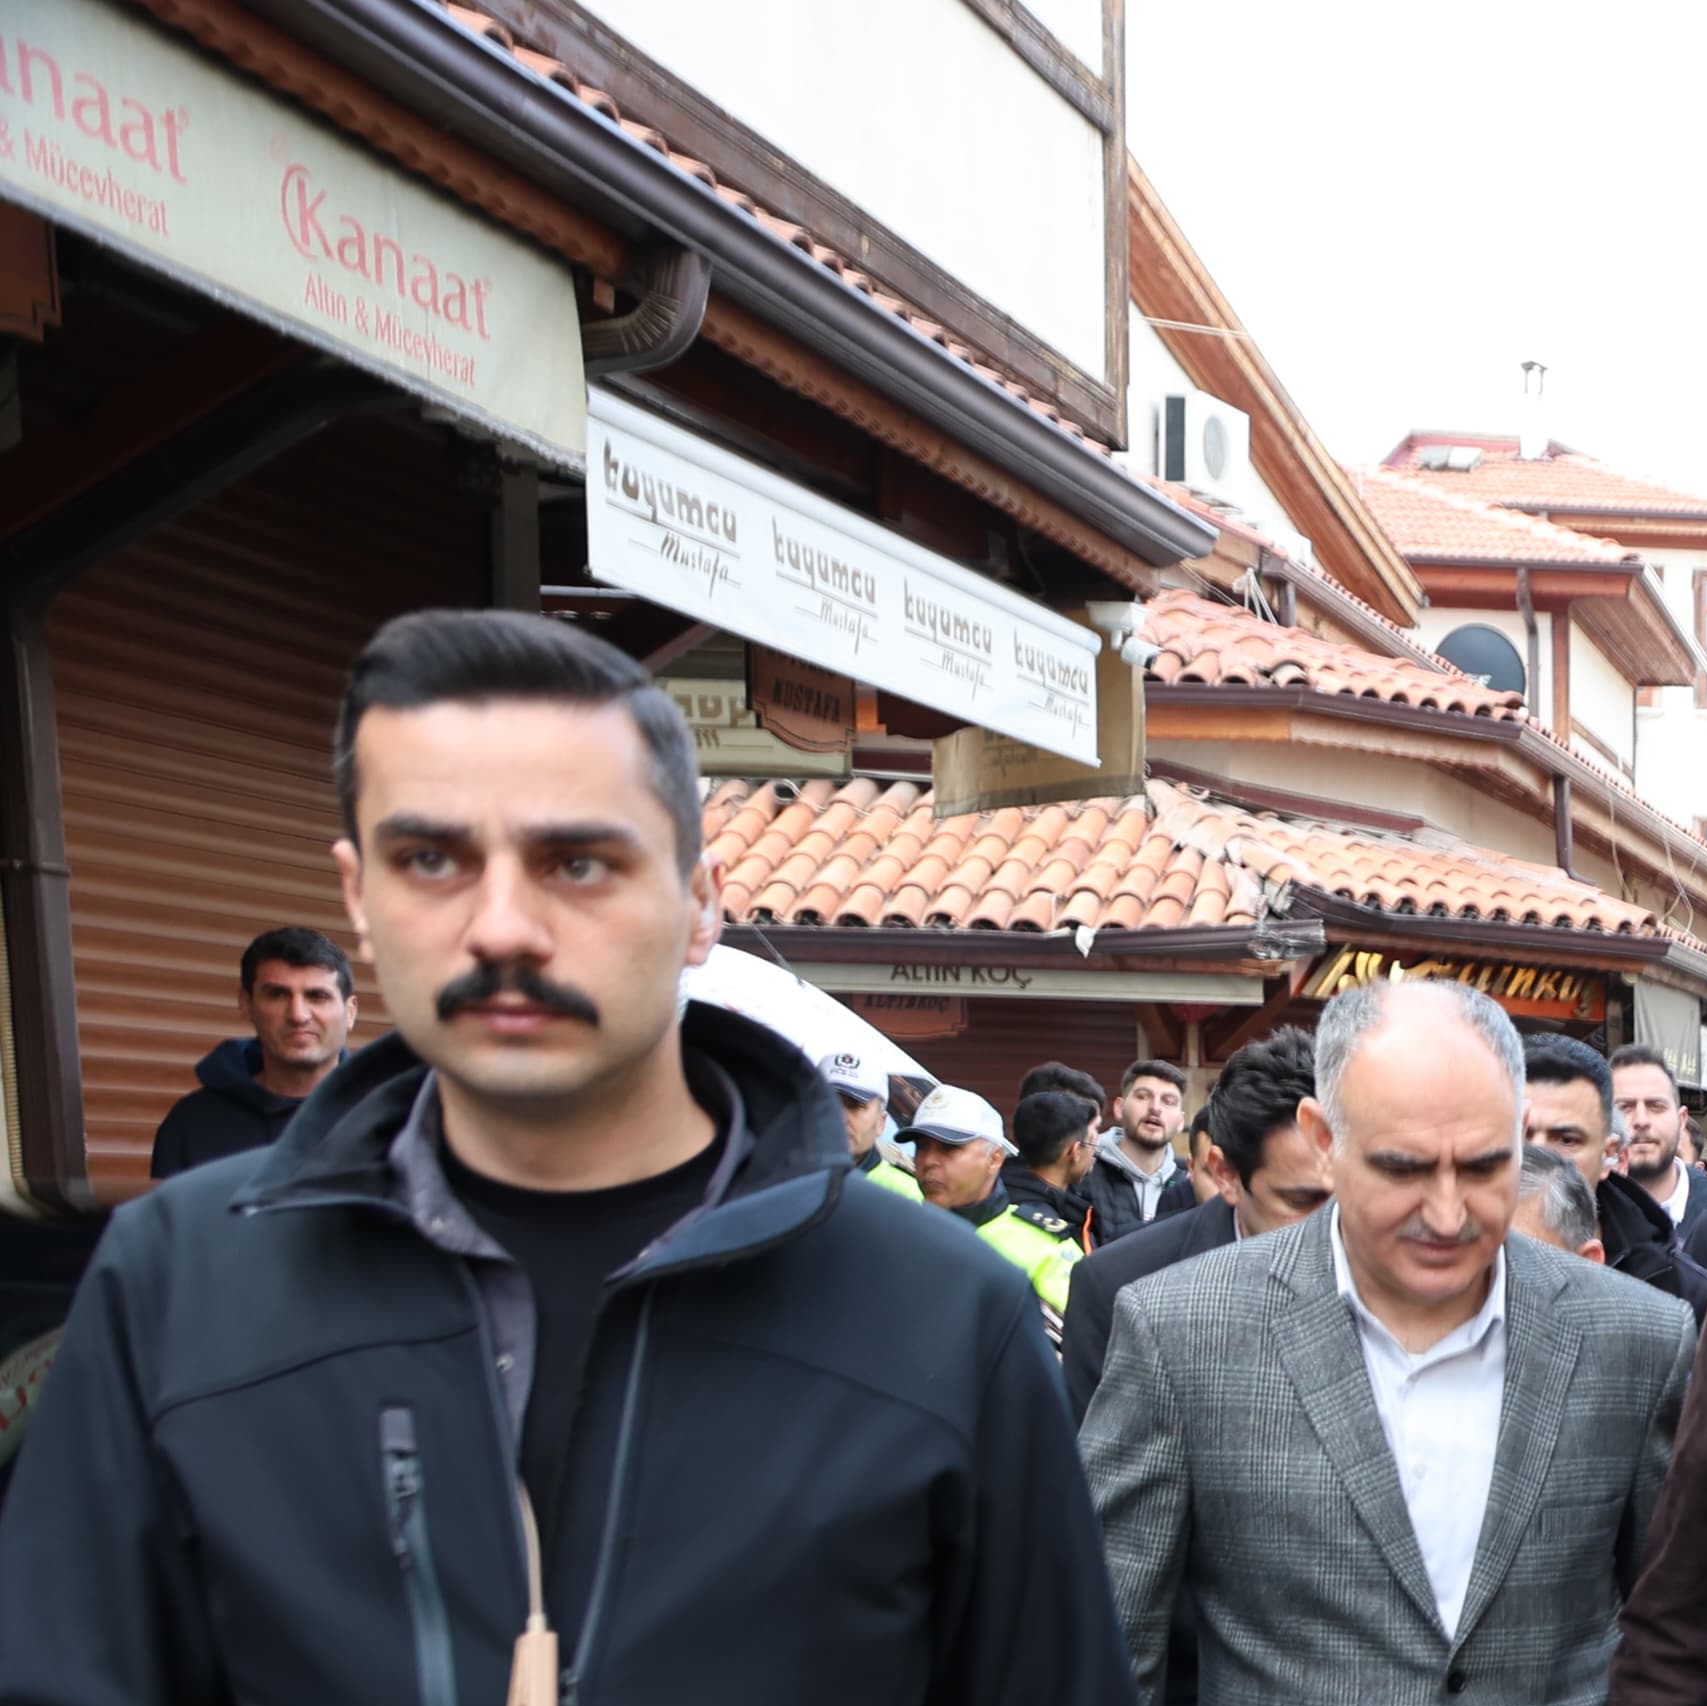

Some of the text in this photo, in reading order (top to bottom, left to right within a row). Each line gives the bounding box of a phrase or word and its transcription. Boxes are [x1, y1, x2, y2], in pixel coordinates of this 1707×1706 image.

[23, 127, 168, 237] Mücevherat
[281, 162, 491, 342] Kanaat
[354, 296, 369, 336] &
[375, 305, 475, 387] Mücevherat
[771, 513, 876, 605] kuyumcu
[903, 574, 993, 655] kuyumcu
[1013, 626, 1089, 695] kuyumcu
